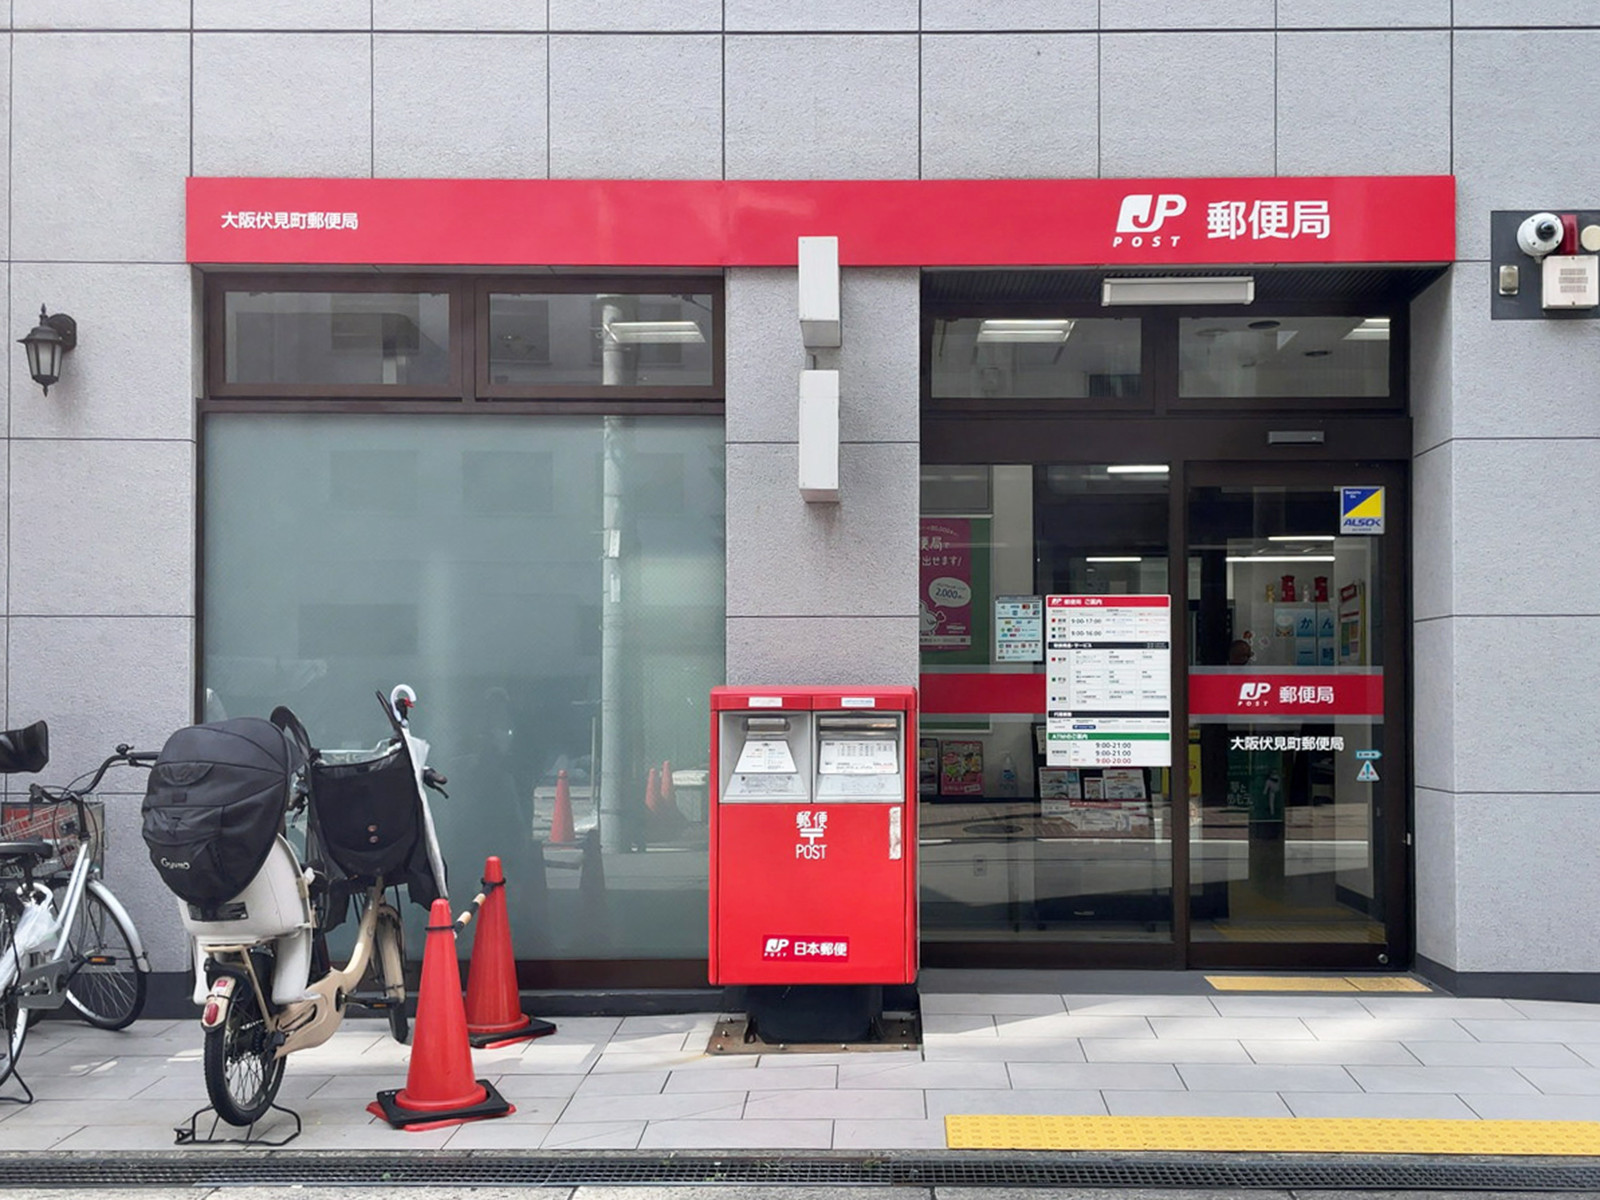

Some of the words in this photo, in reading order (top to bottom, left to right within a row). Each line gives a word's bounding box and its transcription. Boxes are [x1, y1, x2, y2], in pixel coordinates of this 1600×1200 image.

[220, 211, 359, 230] 大阪伏見町郵便局
[1206, 200, 1331, 240] 郵便局
[1112, 236, 1181, 248] POST
[1343, 518, 1381, 527] ALSOK
[1279, 686, 1334, 704] 郵便局
[1230, 736, 1345, 751] 大阪伏見町郵便局
[796, 811, 828, 829] 郵便
[796, 844, 828, 859] POST
[794, 942, 848, 957] 日本郵便
